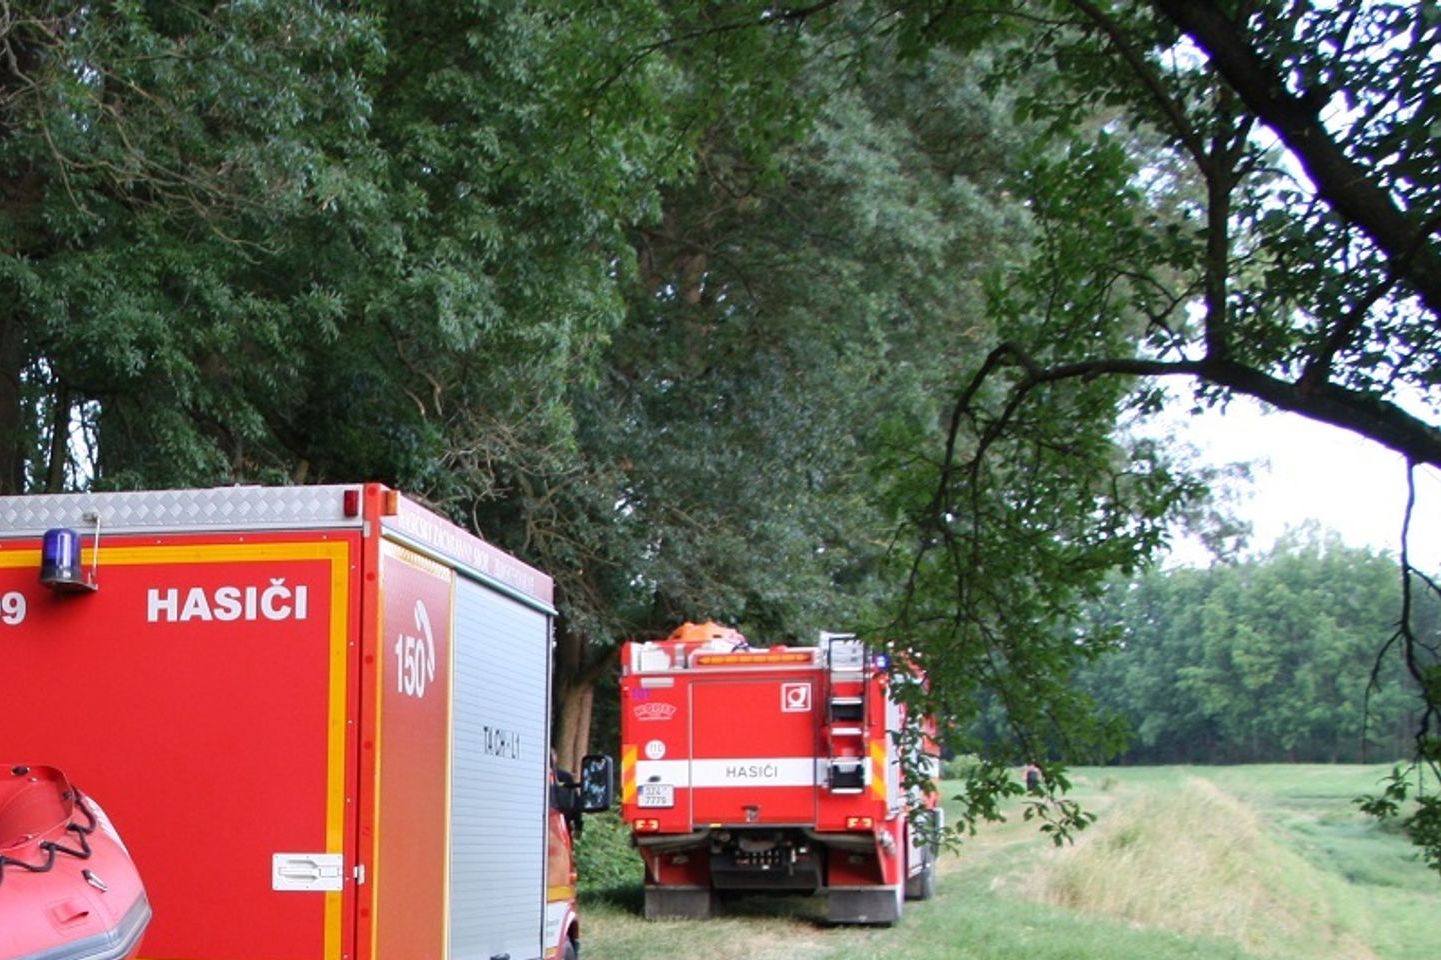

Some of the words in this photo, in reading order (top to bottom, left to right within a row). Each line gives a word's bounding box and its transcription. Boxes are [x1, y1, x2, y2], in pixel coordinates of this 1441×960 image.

[147, 578, 307, 623] HASIČI
[395, 633, 426, 698] 150
[726, 765, 778, 778] HASIČI
